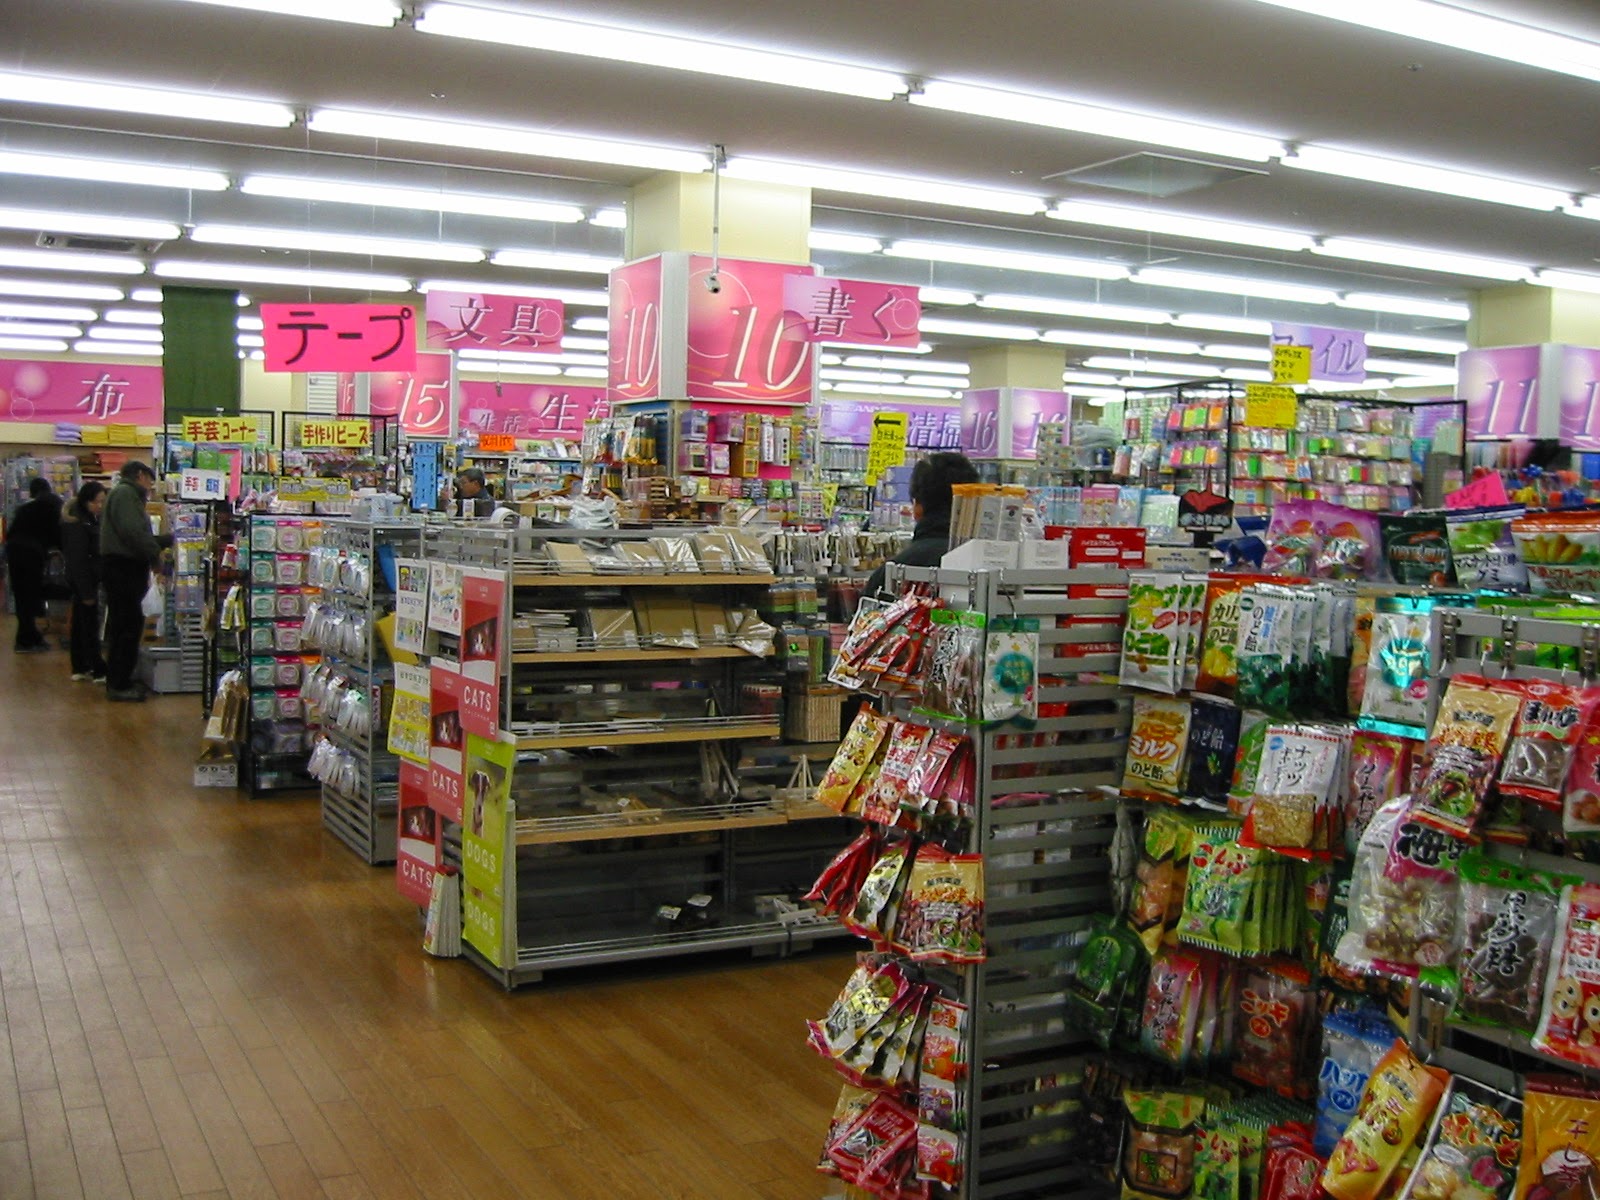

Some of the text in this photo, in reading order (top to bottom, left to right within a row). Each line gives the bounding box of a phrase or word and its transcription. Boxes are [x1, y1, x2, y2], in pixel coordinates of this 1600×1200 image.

[445, 297, 544, 347] 文具
[809, 286, 896, 342] 書く
[277, 306, 413, 366] テープ
[617, 302, 660, 389] 10
[712, 306, 809, 390] 10
[76, 372, 131, 420] 布
[390, 378, 449, 428] 15
[1474, 378, 1537, 440] 11
[1573, 381, 1600, 441] 1
[186, 420, 257, 442] 手芸コーナー
[967, 411, 998, 453] 16
[1023, 411, 1061, 454] 1
[1245, 606, 1264, 653] のど飴
[463, 685, 492, 713] CATS
[1129, 735, 1178, 761] ミルク
[1191, 724, 1225, 750] のど飴
[432, 770, 459, 798] CATS
[1131, 762, 1164, 781] のど飴
[402, 859, 433, 889] CATS
[466, 838, 497, 874] DOGS
[466, 901, 496, 938] DOGS
